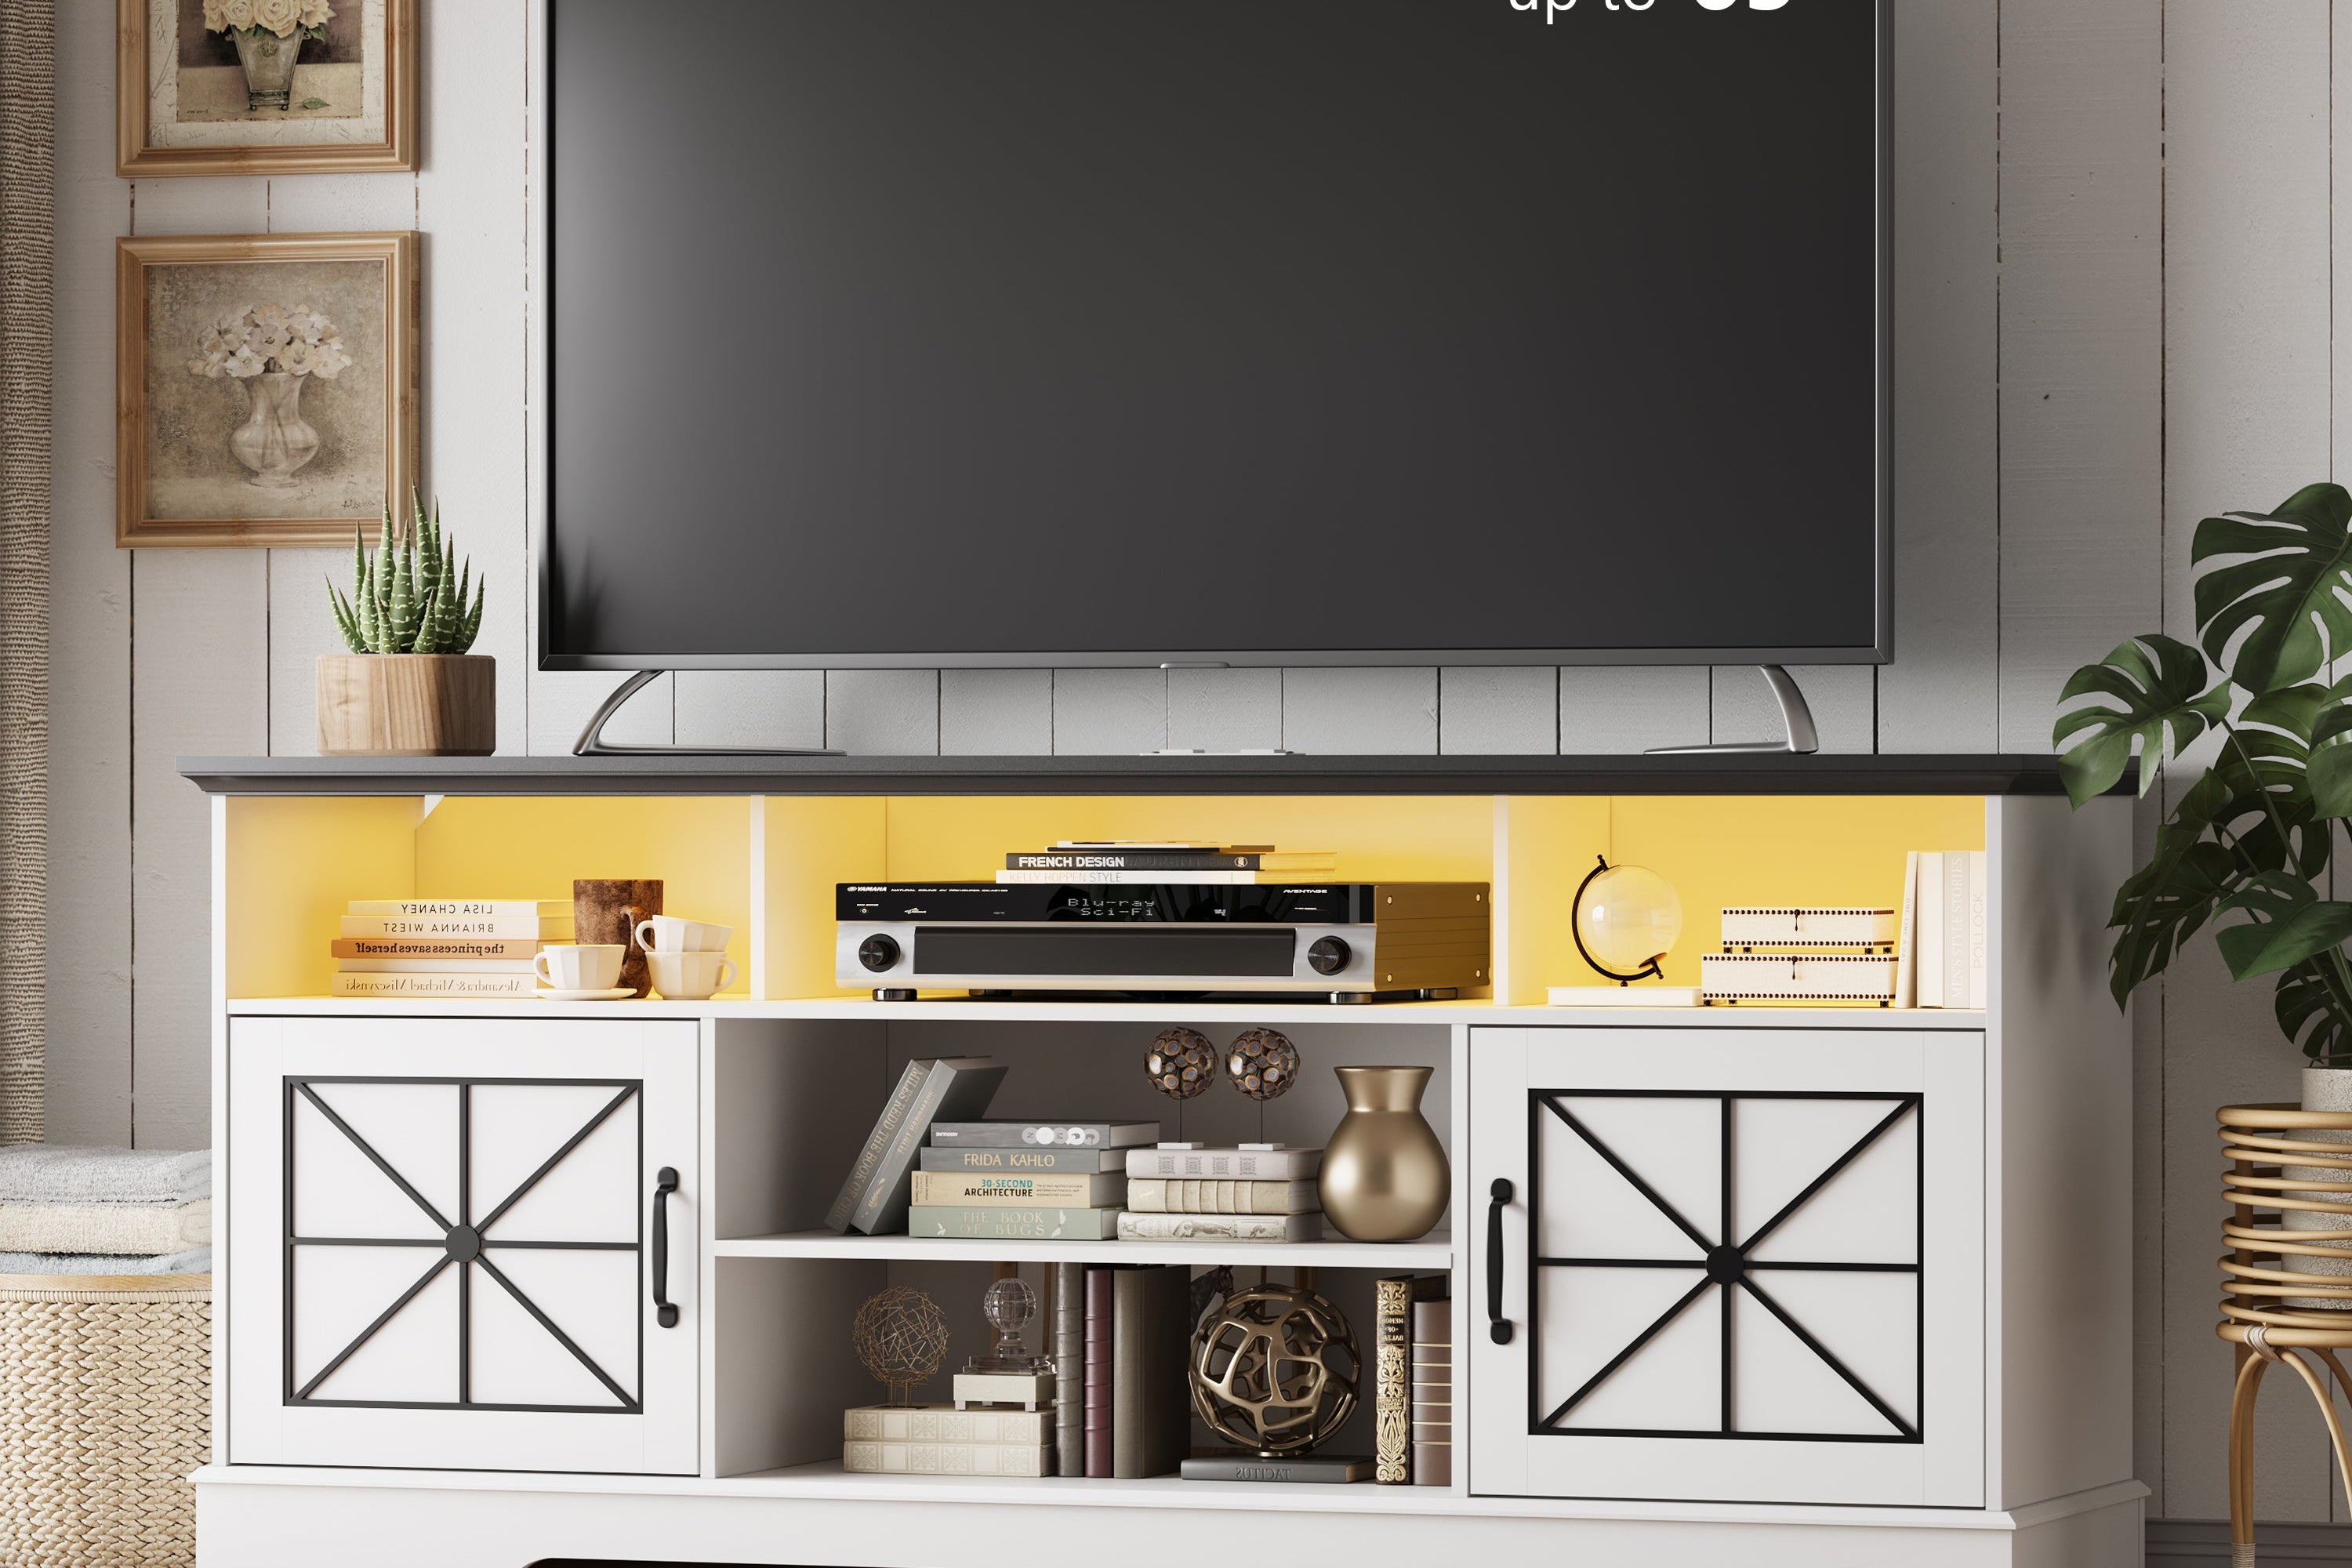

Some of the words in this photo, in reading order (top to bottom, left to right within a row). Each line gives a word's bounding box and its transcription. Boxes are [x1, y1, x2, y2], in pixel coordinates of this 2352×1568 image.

[1019, 856, 1073, 867] FRENCH
[1076, 856, 1125, 867] DESIGN
[1009, 872, 1040, 883] KELLY
[1044, 872, 1086, 883] HOPPEN
[1090, 872, 1122, 883] STYLE
[1951, 858, 1963, 912] STORIES
[1068, 898, 1155, 908] Blu-ray
[1080, 908, 1154, 916] Sci-Fi
[1951, 915, 1963, 955] STYLE
[1973, 892, 1984, 969] POLLOCK
[898, 1067, 923, 1103] MILES
[884, 1100, 906, 1131] REDD
[871, 1130, 890, 1153] THE
[897, 1131, 913, 1154] FLINT
[854, 1150, 879, 1182] BOOK
[964, 1153, 1002, 1167] FRIDA
[1010, 1154, 1055, 1167] KAHLO
[847, 1181, 861, 1198] OF
[981, 1179, 1033, 1188] 30-SECOND
[964, 1188, 1033, 1197] ARCHITECTURE
[960, 1211, 989, 1223] THE
[1001, 1211, 1043, 1224] BOOK
[960, 1223, 981, 1235] OF
[995, 1223, 1045, 1236] BUGS
